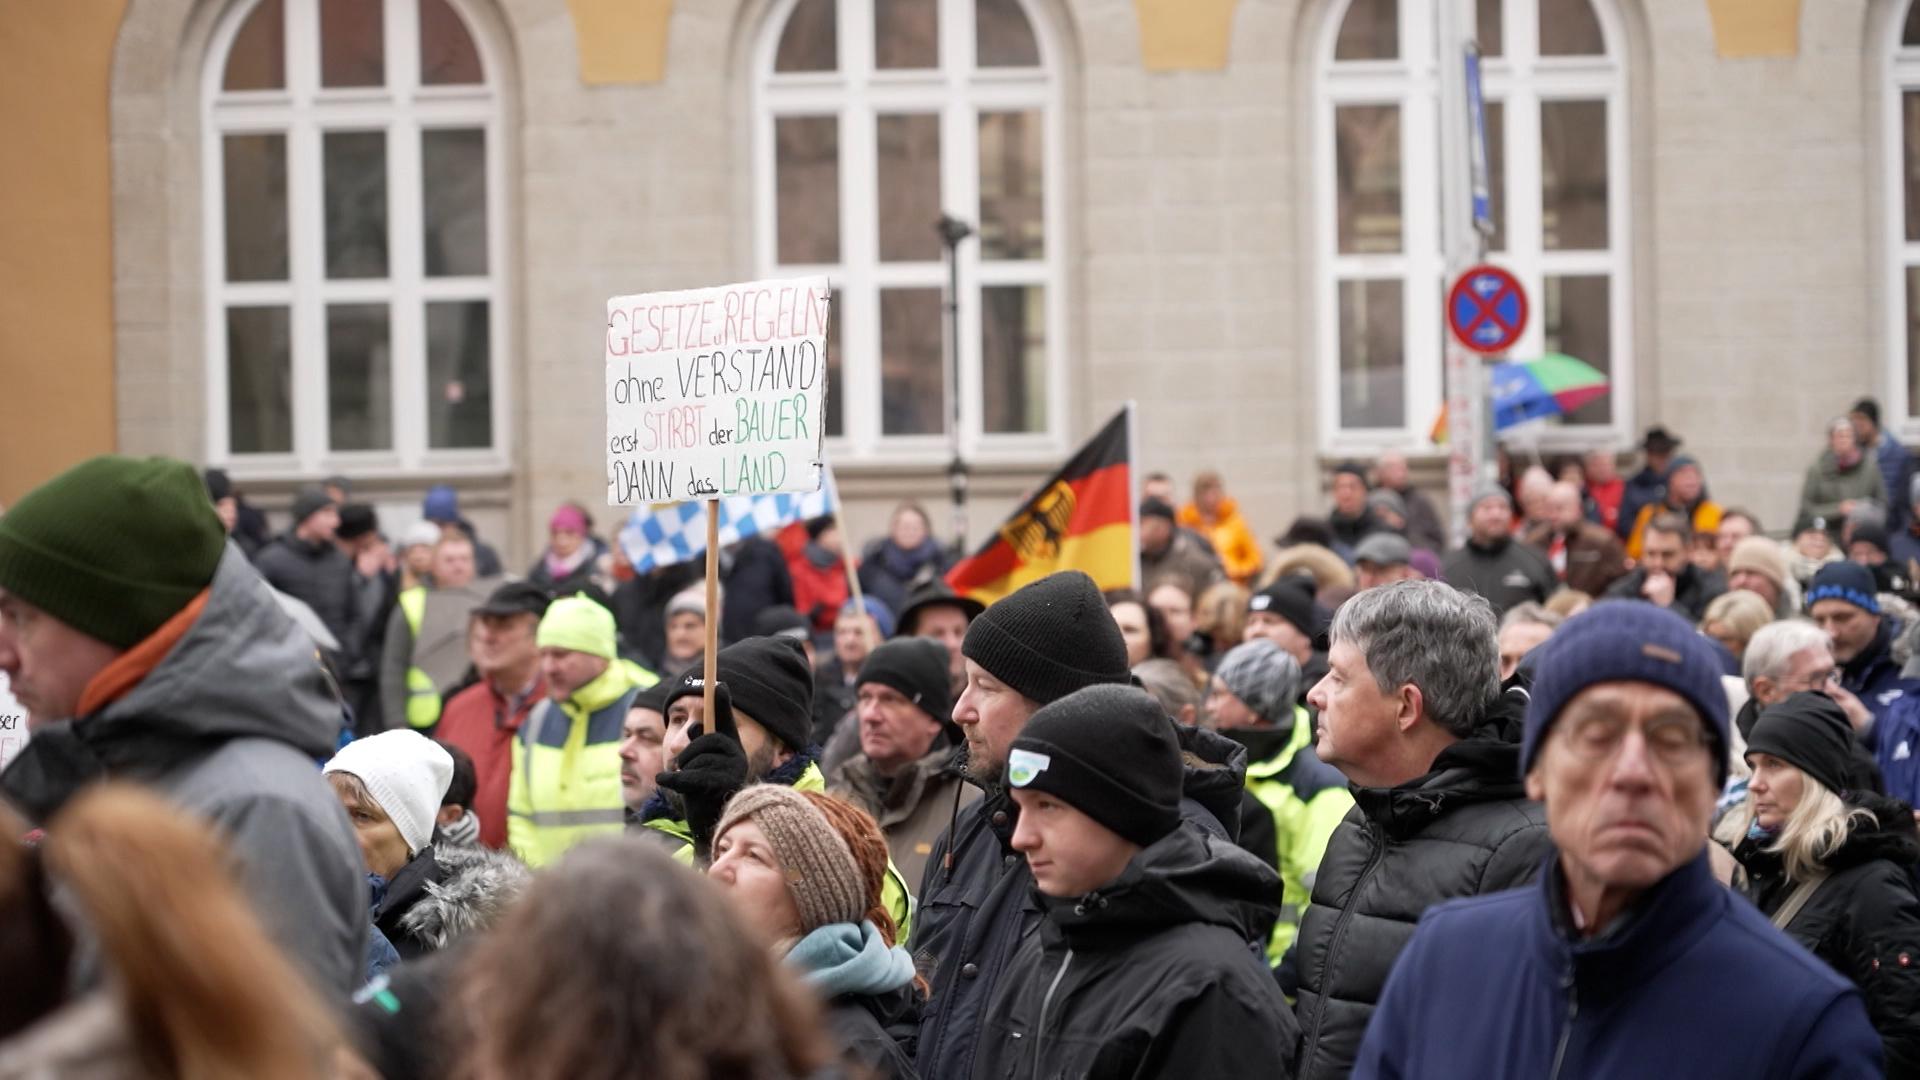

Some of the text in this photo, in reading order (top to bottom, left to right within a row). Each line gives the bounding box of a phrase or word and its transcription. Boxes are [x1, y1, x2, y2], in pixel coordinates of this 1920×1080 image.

[608, 302, 715, 356] GESETZE
[723, 288, 825, 343] REGELN
[615, 340, 817, 404] ohne VERSTAND
[610, 393, 808, 454] erst STIRBT der BAUER
[614, 452, 786, 504] DANN das LAND
